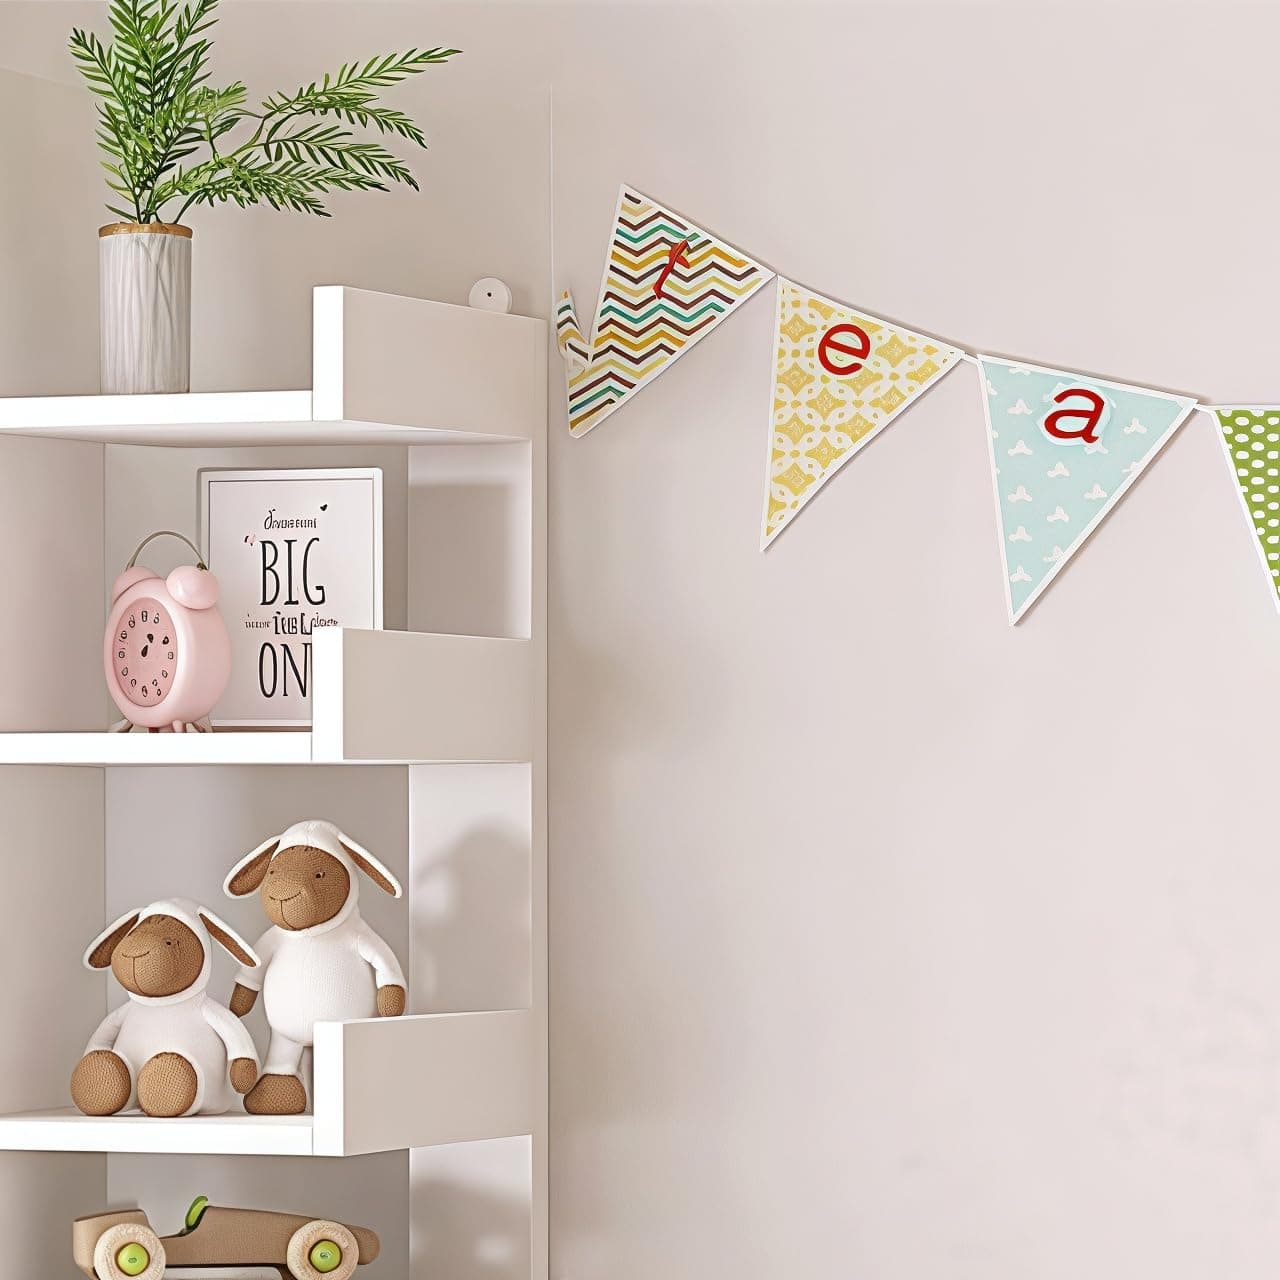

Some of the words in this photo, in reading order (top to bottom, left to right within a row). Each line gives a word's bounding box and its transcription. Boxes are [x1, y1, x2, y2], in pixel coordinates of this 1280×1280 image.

[818, 323, 871, 376] e
[1044, 388, 1105, 443] a
[259, 537, 326, 606] BIG
